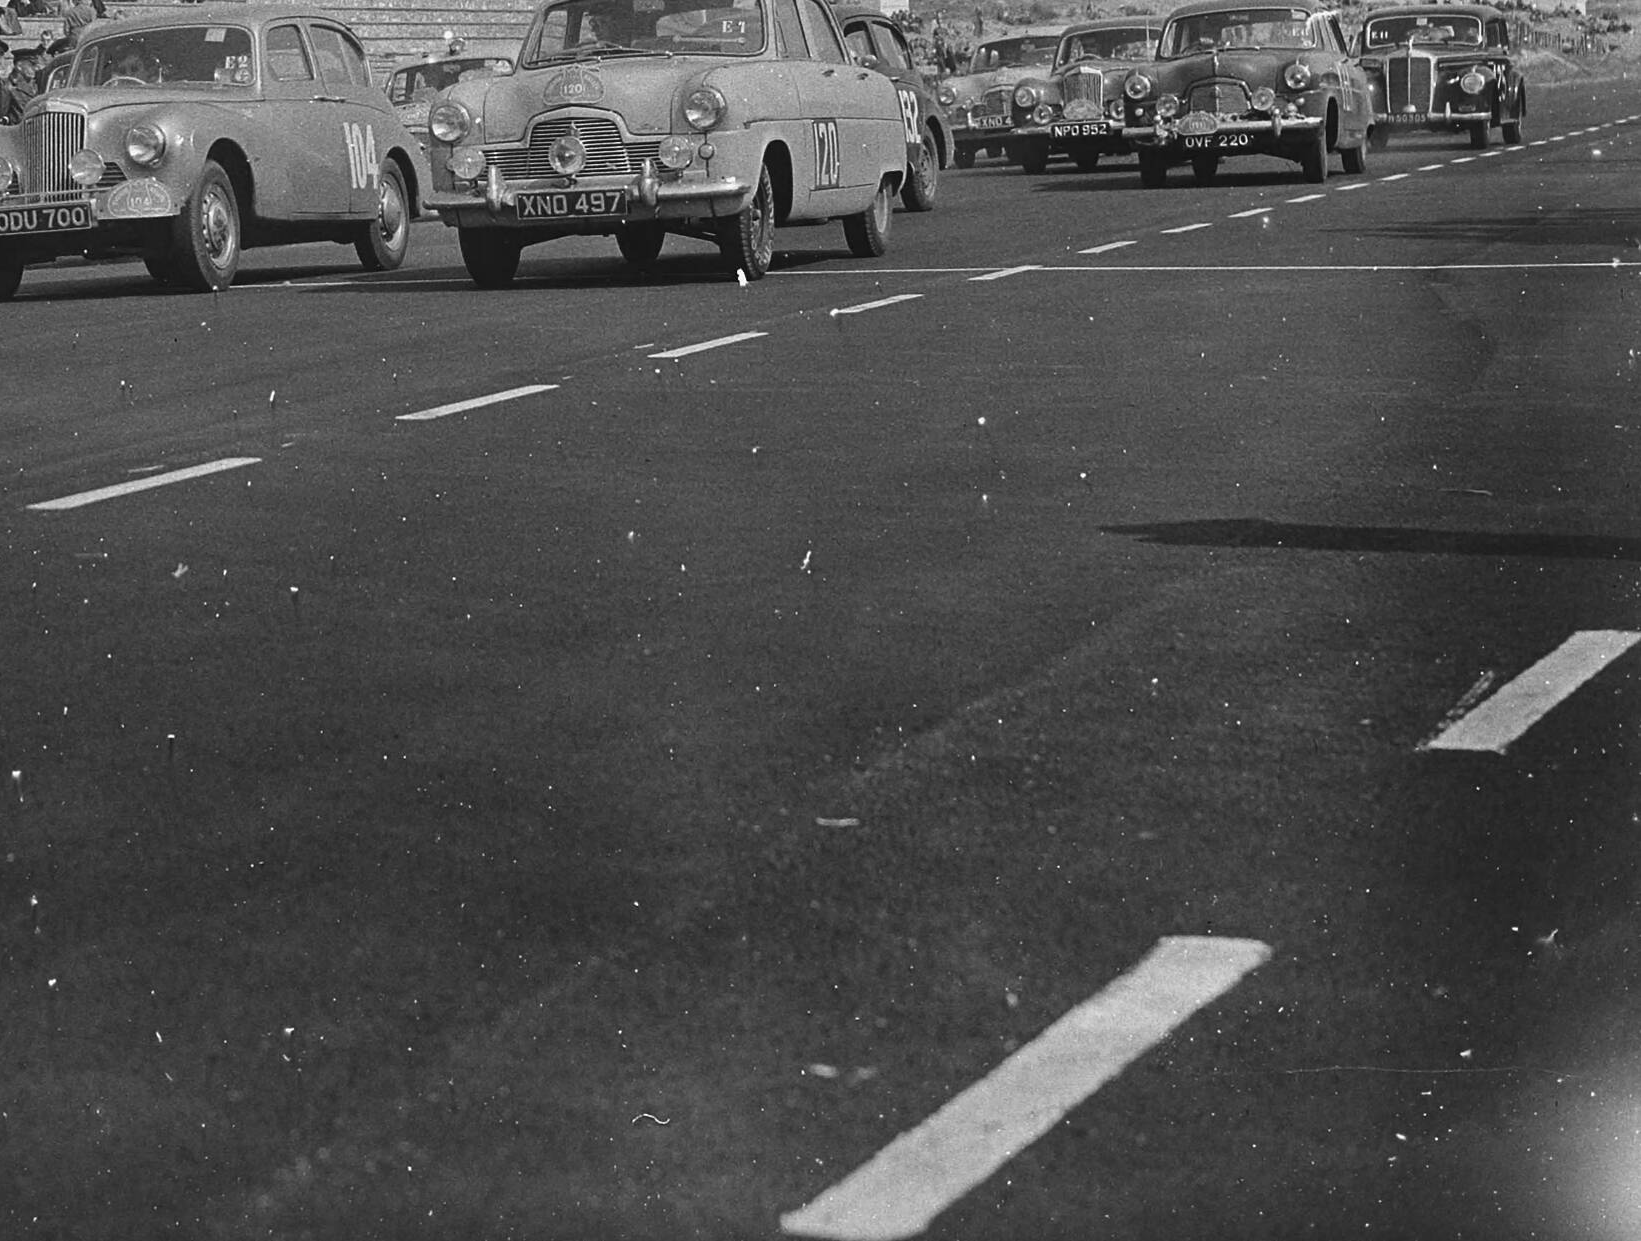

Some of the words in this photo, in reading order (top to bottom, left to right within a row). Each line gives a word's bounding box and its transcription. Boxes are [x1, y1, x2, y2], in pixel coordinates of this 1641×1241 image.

[563, 83, 583, 95] 120
[898, 89, 921, 144] 132
[1054, 126, 1079, 137] NPO
[1082, 124, 1108, 136] 952
[1185, 135, 1214, 148] OVF
[1218, 133, 1249, 147] 220
[343, 122, 380, 189] 104
[813, 121, 839, 185] 120
[130, 197, 151, 208] 104
[522, 194, 567, 215] XNO
[575, 192, 620, 213] 497
[42, 207, 86, 228] 700
